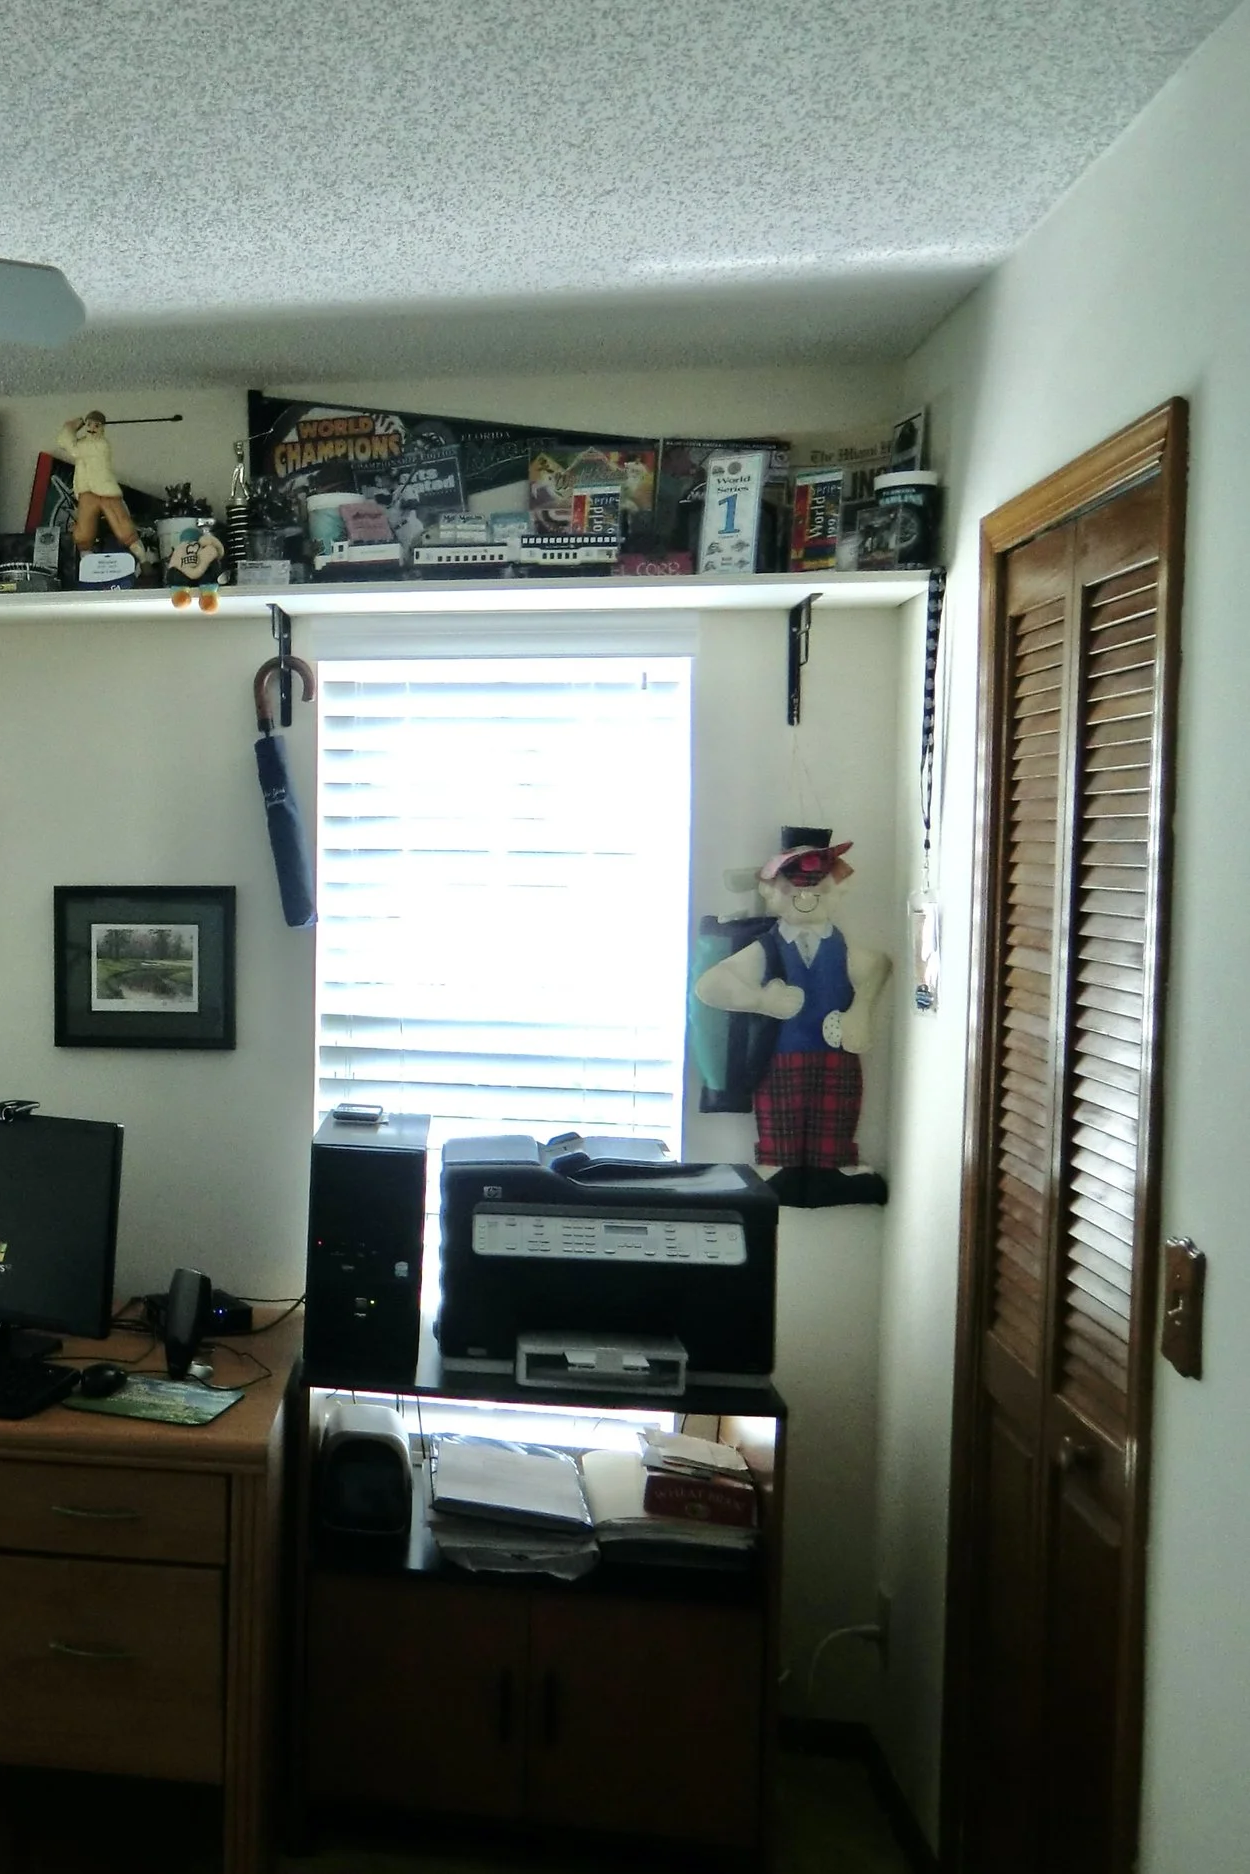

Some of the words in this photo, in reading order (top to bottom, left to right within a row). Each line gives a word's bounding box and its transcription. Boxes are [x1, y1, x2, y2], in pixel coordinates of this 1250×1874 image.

[297, 415, 374, 439] WORLD
[461, 430, 511, 441] FLORIDA
[273, 433, 402, 478] CHAMPIONS
[716, 476, 751, 484] World
[588, 506, 604, 533] orld
[717, 493, 740, 535] 1
[808, 494, 826, 538] World
